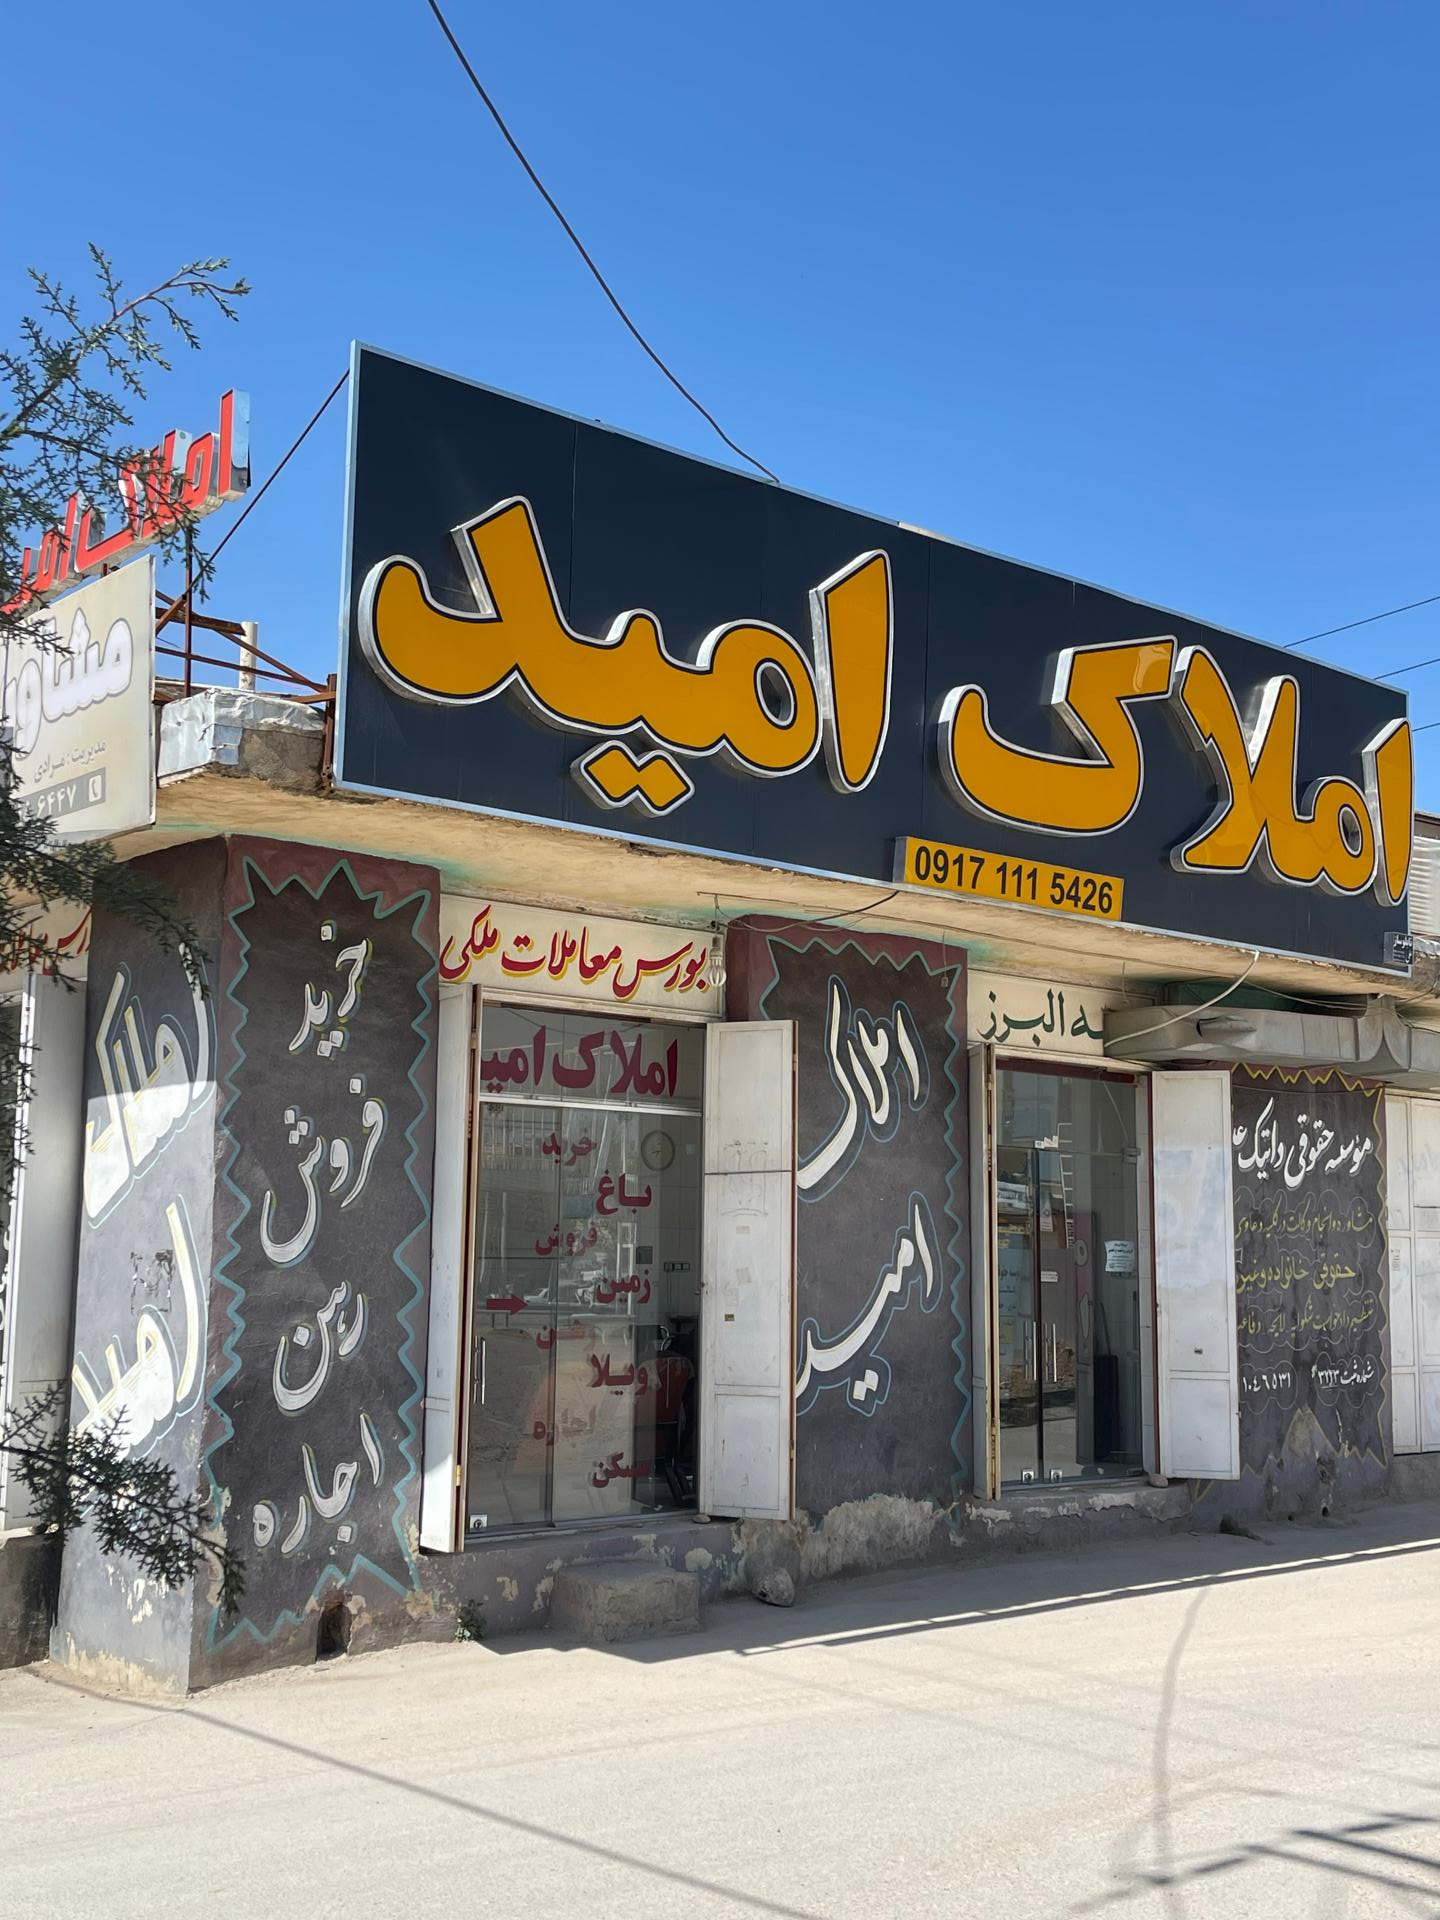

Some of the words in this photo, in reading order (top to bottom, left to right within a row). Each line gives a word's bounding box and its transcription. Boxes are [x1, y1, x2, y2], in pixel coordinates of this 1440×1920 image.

[358, 495, 893, 818] امید
[938, 635, 1414, 906] املاک
[914, 845, 986, 890] 0917
[995, 860, 1038, 901] 111
[1050, 876, 1113, 914] 5426
[439, 904, 500, 981] ملکی
[500, 926, 622, 983] معاملات
[613, 941, 707, 1000] بورس
[289, 925, 366, 1056] خرید
[976, 988, 1065, 1047] البرز
[480, 1025, 546, 1094] امی
[552, 1030, 678, 1097] املاک
[260, 1078, 384, 1264] فروش
[543, 1128, 598, 1166] خرید
[1283, 1113, 1335, 1188] حقوقی
[596, 1169, 652, 1215] باغ
[535, 1221, 598, 1256] فروش
[1313, 1252, 1358, 1290] حقوقی
[597, 1269, 651, 1304] زمین
[273, 1281, 365, 1411] رهن
[591, 1353, 649, 1396] ویلا
[252, 1413, 381, 1555] اجاره
